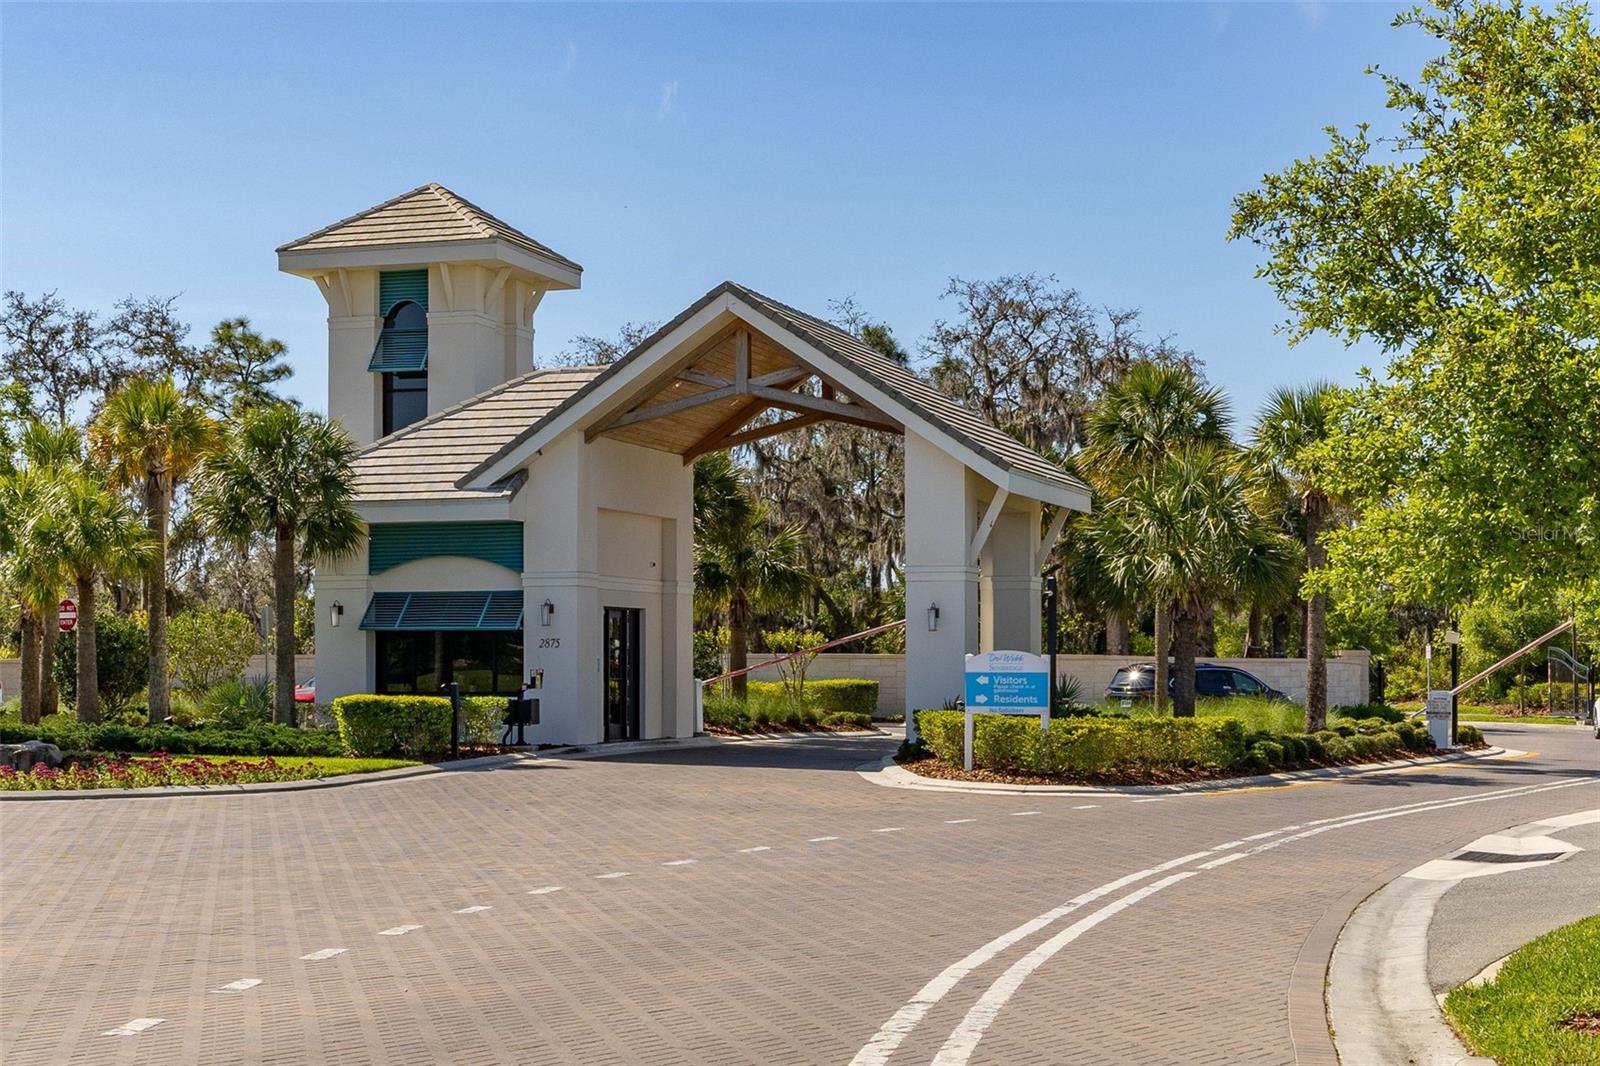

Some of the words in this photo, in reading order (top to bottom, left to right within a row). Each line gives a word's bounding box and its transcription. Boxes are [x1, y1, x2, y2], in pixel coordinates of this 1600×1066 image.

[539, 638, 561, 649] 2875
[993, 675, 1028, 685] Visitors
[993, 695, 1038, 704] Residents
